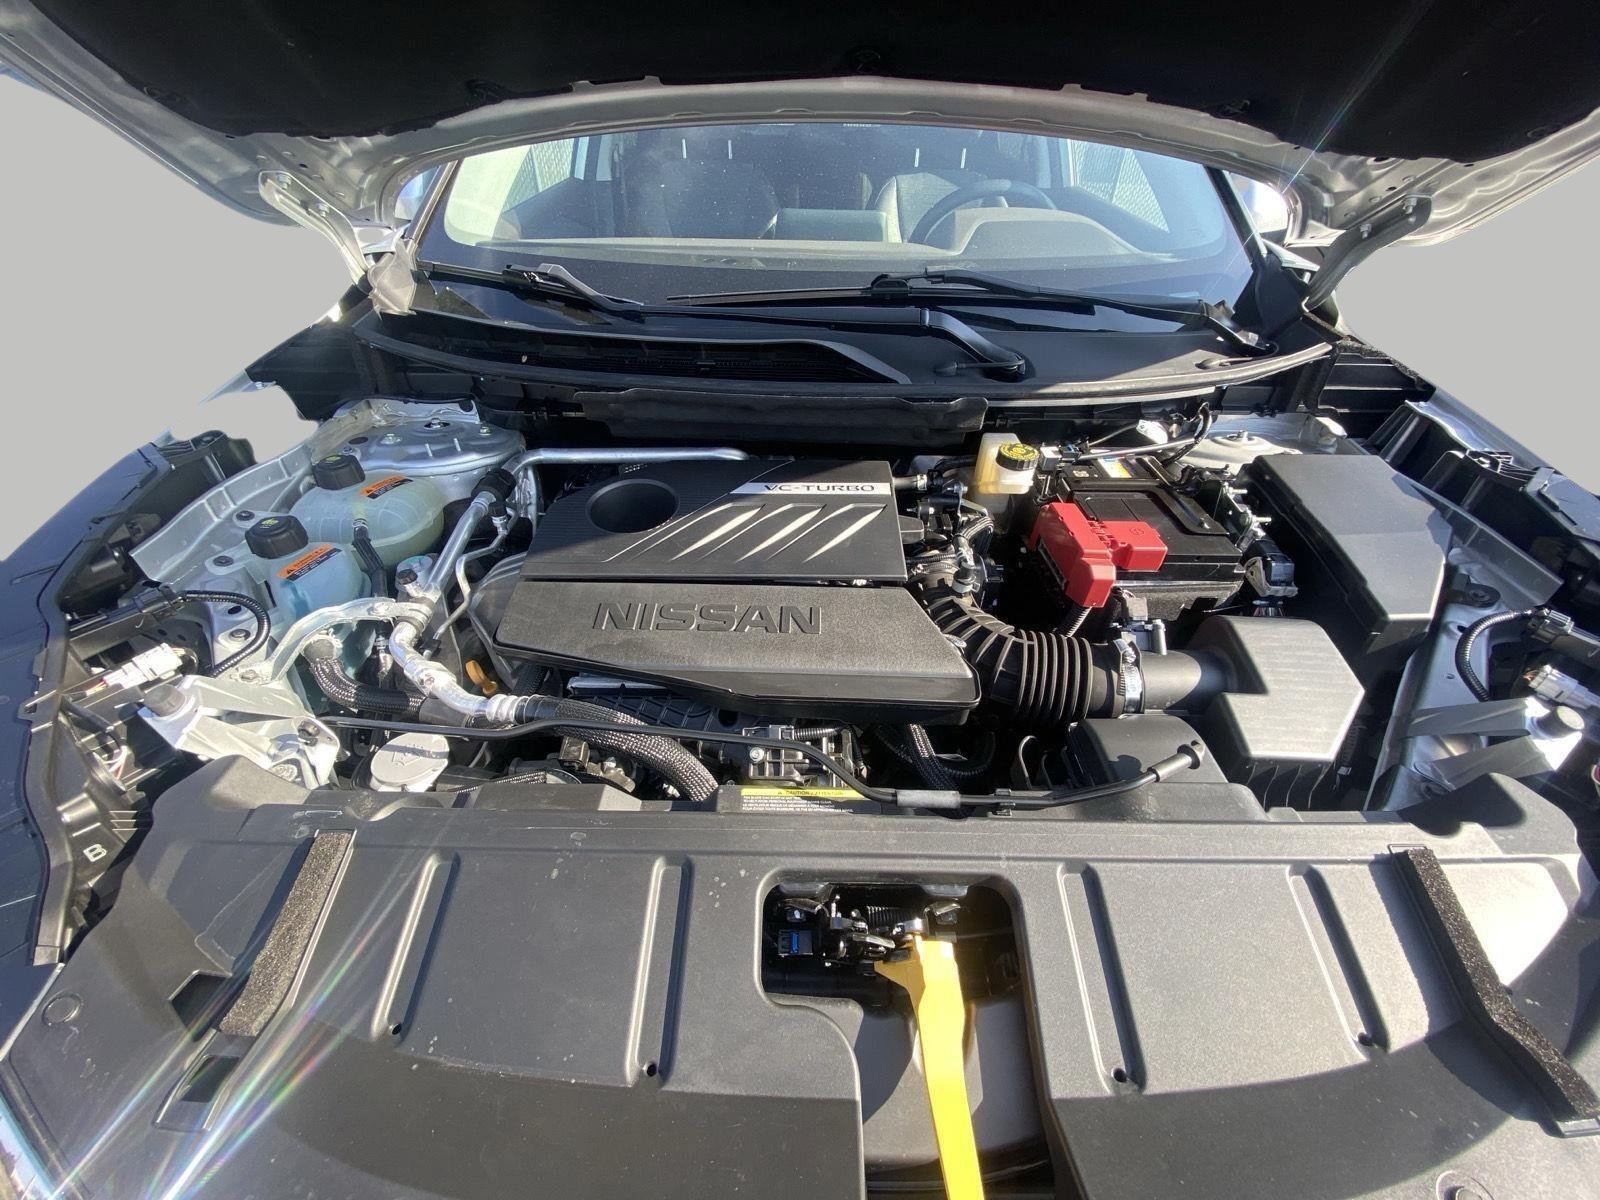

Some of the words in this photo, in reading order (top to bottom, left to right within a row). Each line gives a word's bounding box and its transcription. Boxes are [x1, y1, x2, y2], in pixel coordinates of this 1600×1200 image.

[764, 484, 875, 492] VC-TURBO
[592, 602, 822, 634] NISSAN
[83, 843, 107, 862] B
